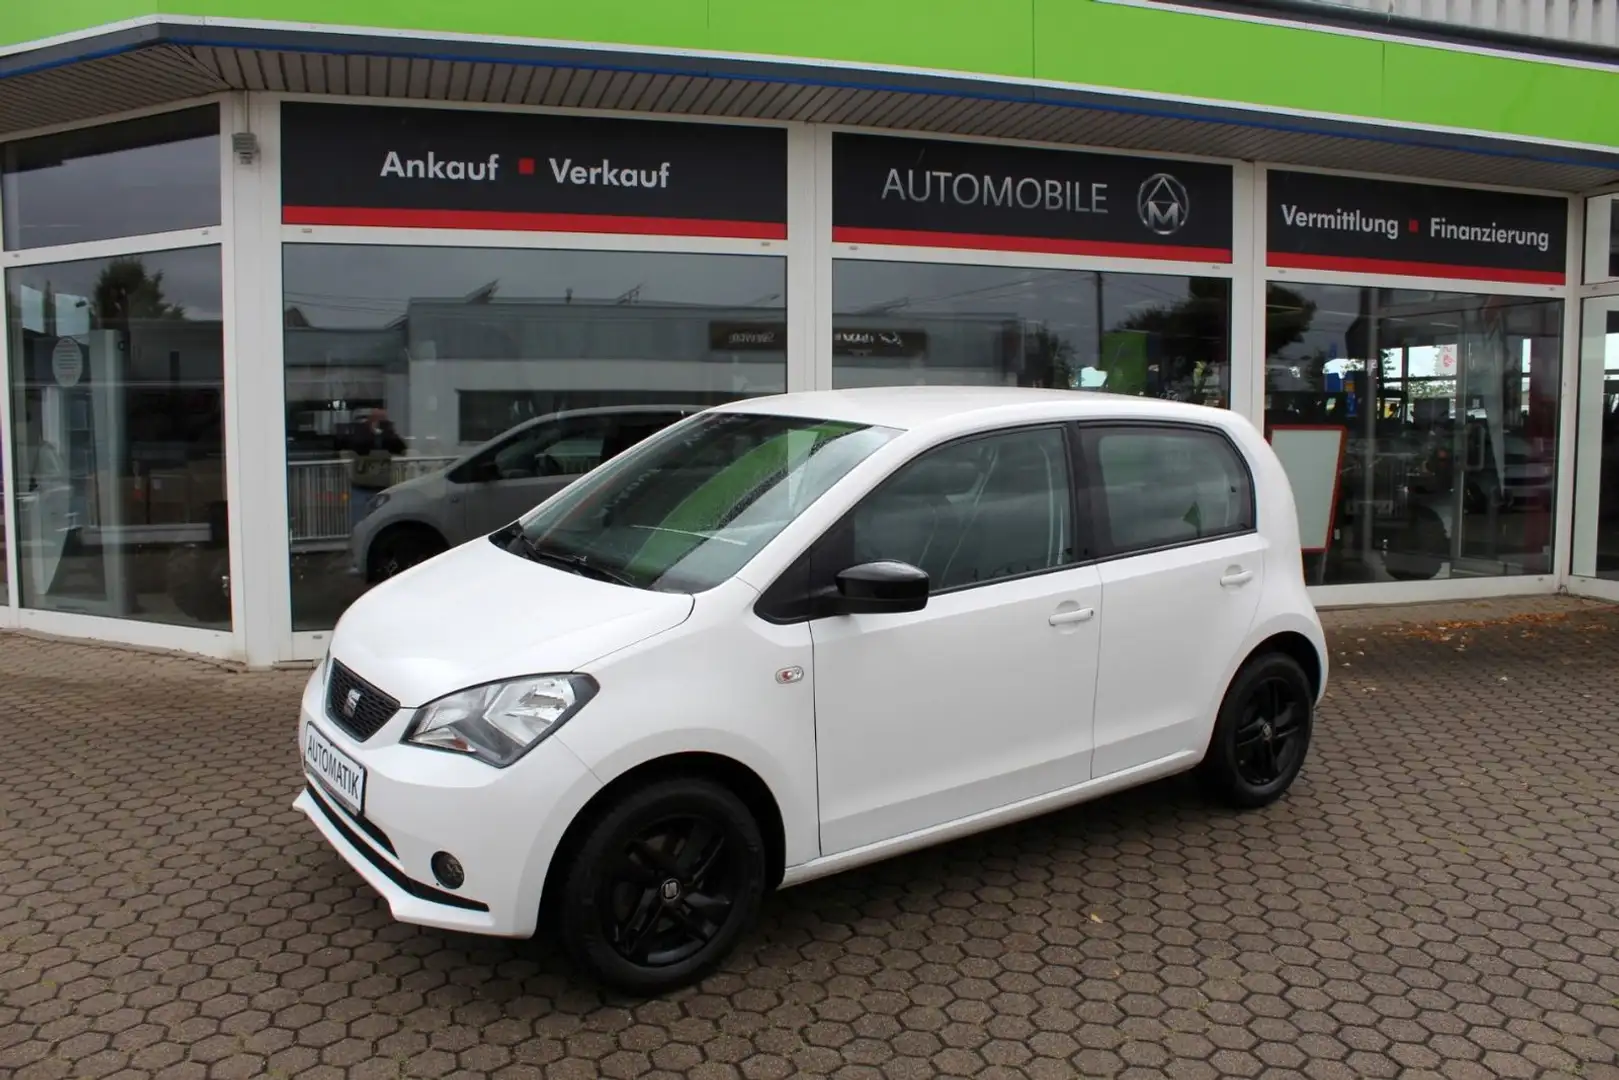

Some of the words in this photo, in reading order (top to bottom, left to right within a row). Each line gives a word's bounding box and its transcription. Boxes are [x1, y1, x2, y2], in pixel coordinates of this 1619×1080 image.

[379, 151, 500, 182] Ankauf
[548, 157, 671, 189] Verkauf
[881, 168, 1108, 215] AUTOMOBILE
[1281, 204, 1399, 241] Vermittlung
[1429, 217, 1550, 252] Finanzierung
[307, 735, 360, 799] AUTOMATIK
